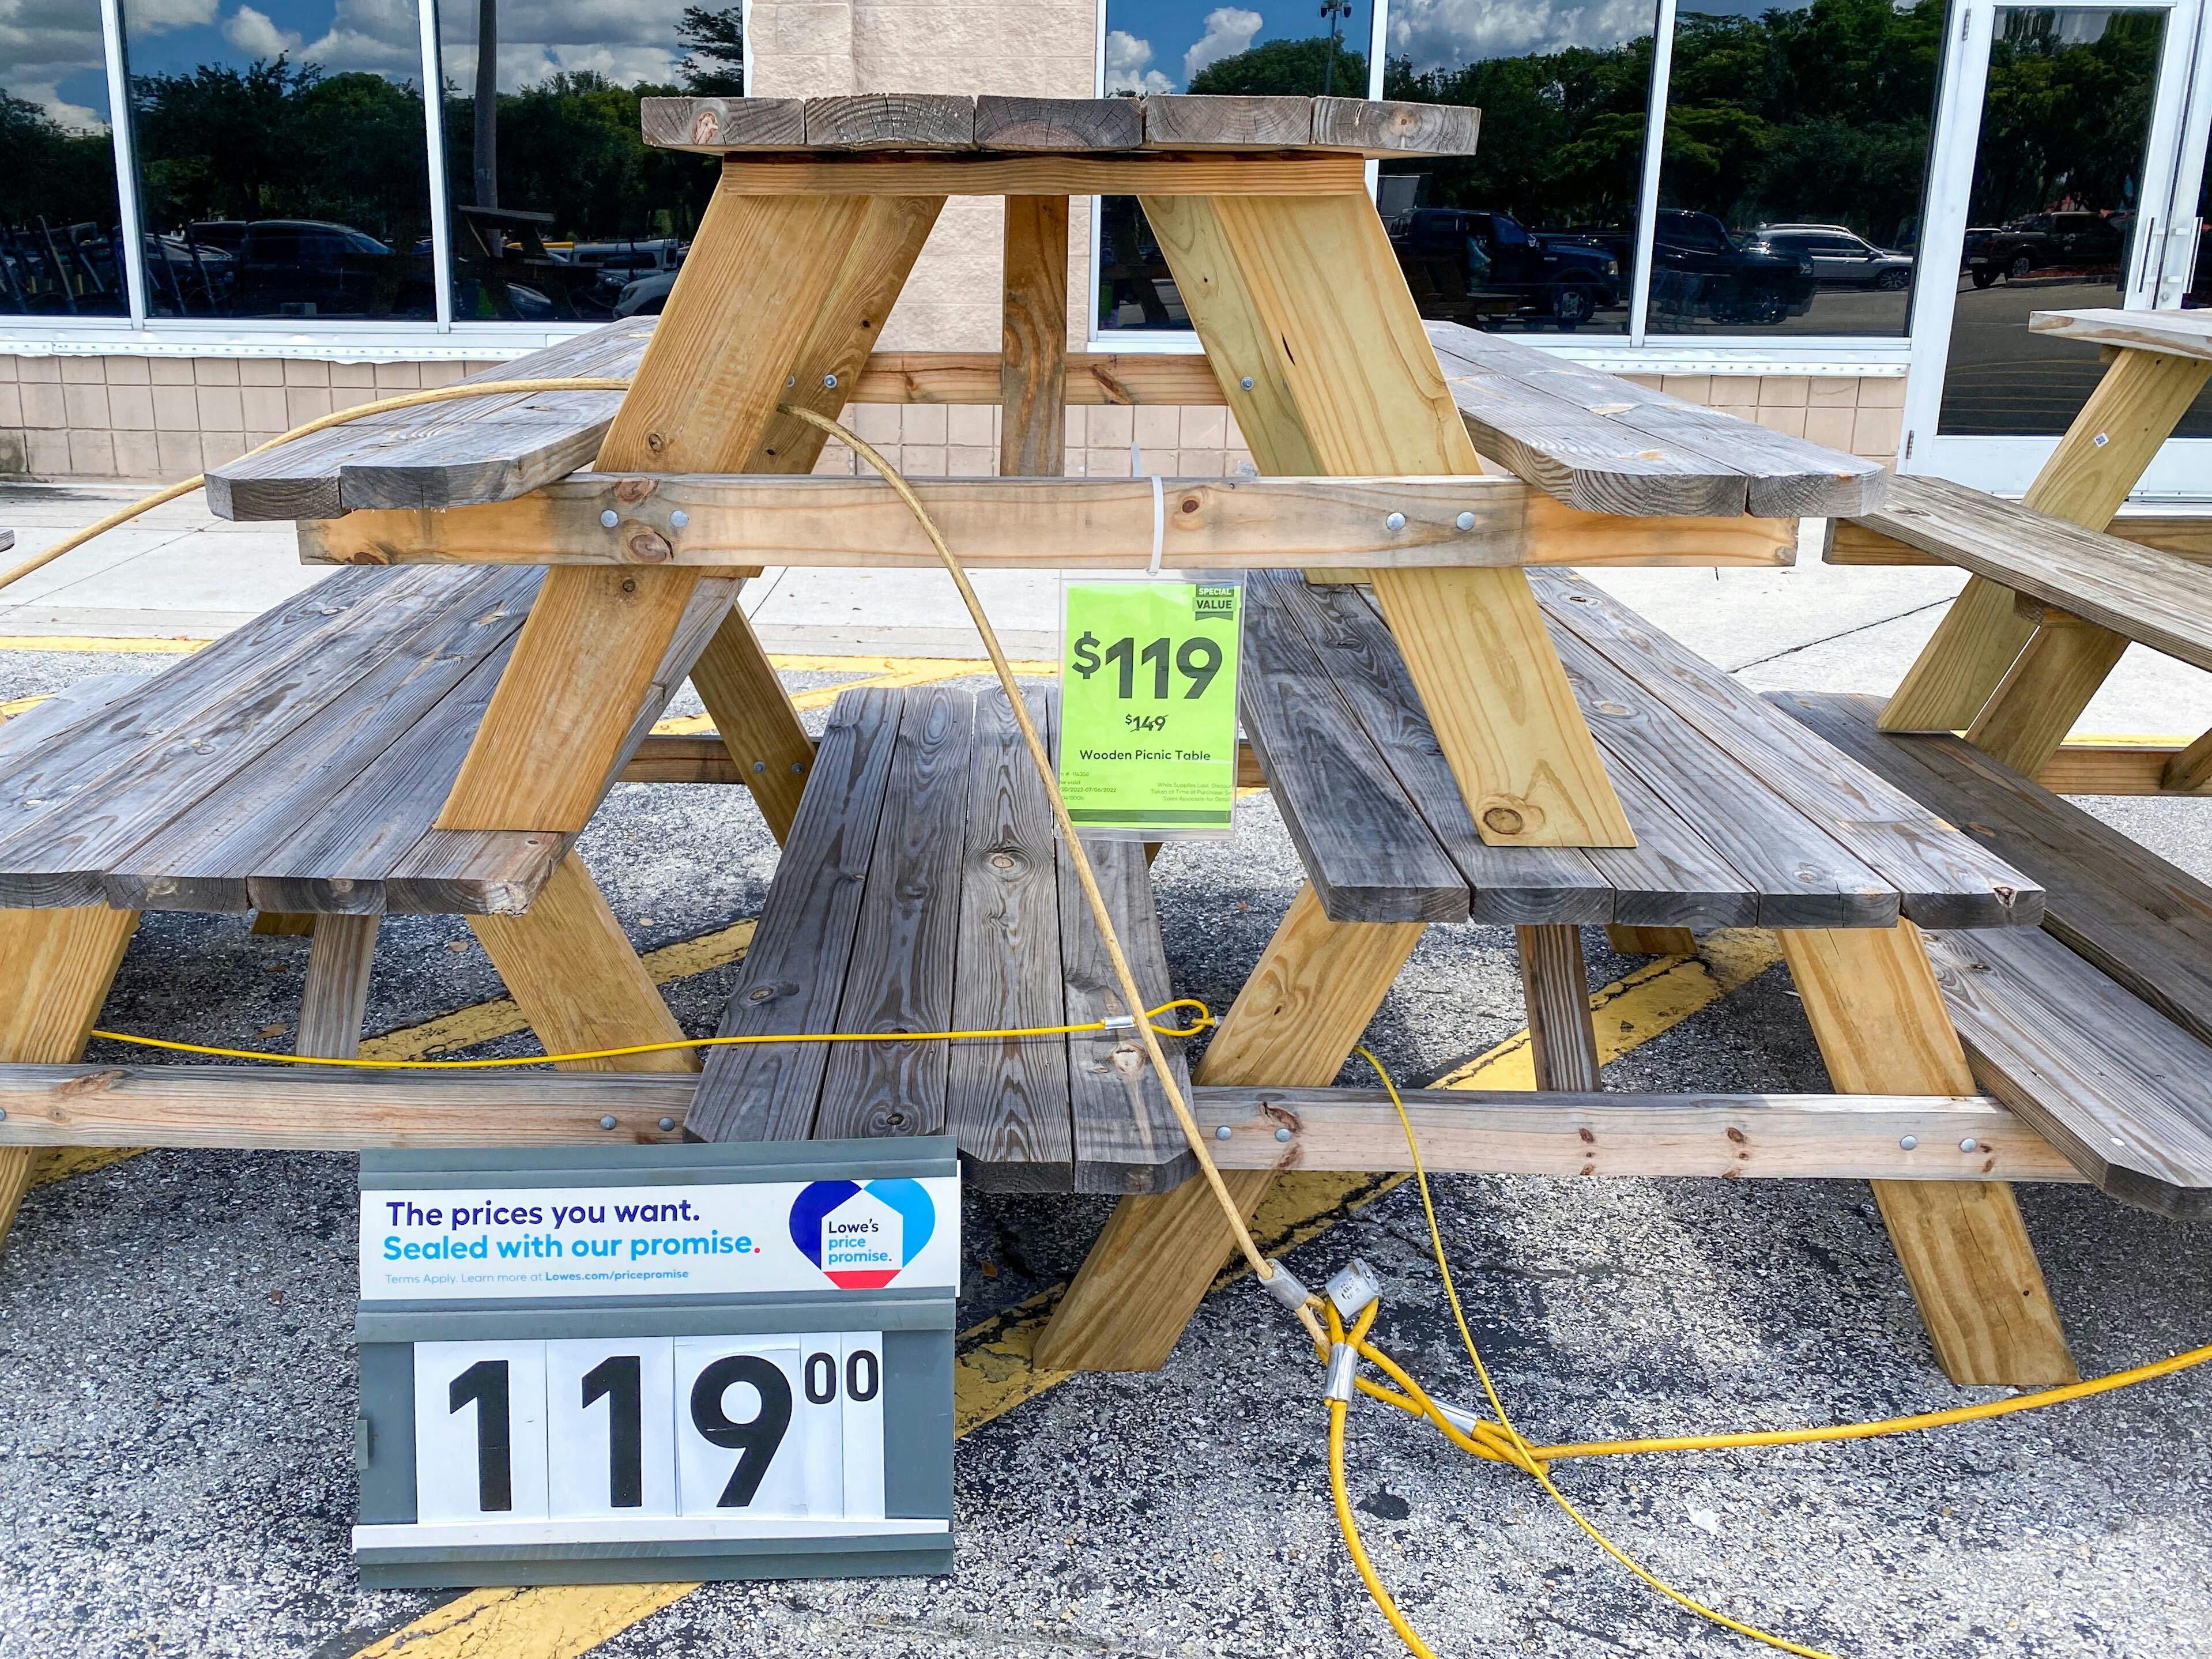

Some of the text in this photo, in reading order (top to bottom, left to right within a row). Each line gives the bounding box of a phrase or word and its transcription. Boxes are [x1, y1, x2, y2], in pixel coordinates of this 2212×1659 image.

[1199, 587, 1231, 595] SPECIAL
[1196, 600, 1232, 609] VALUE
[1072, 631, 1222, 699] $119
[1125, 714, 1166, 732] $149
[1080, 749, 1211, 761] Wooden Picnic Table
[386, 1200, 699, 1231] The prices you want.
[828, 1219, 879, 1234] Lowe's
[383, 1230, 760, 1261] Sealed with our promise.
[828, 1235, 866, 1251] price
[828, 1249, 892, 1265] promise.
[385, 1274, 420, 1284] Terms
[423, 1273, 458, 1285] Apply.
[461, 1273, 494, 1283] Learn
[530, 1273, 542, 1281] at
[545, 1269, 689, 1282] Lowes.com/pricepromise
